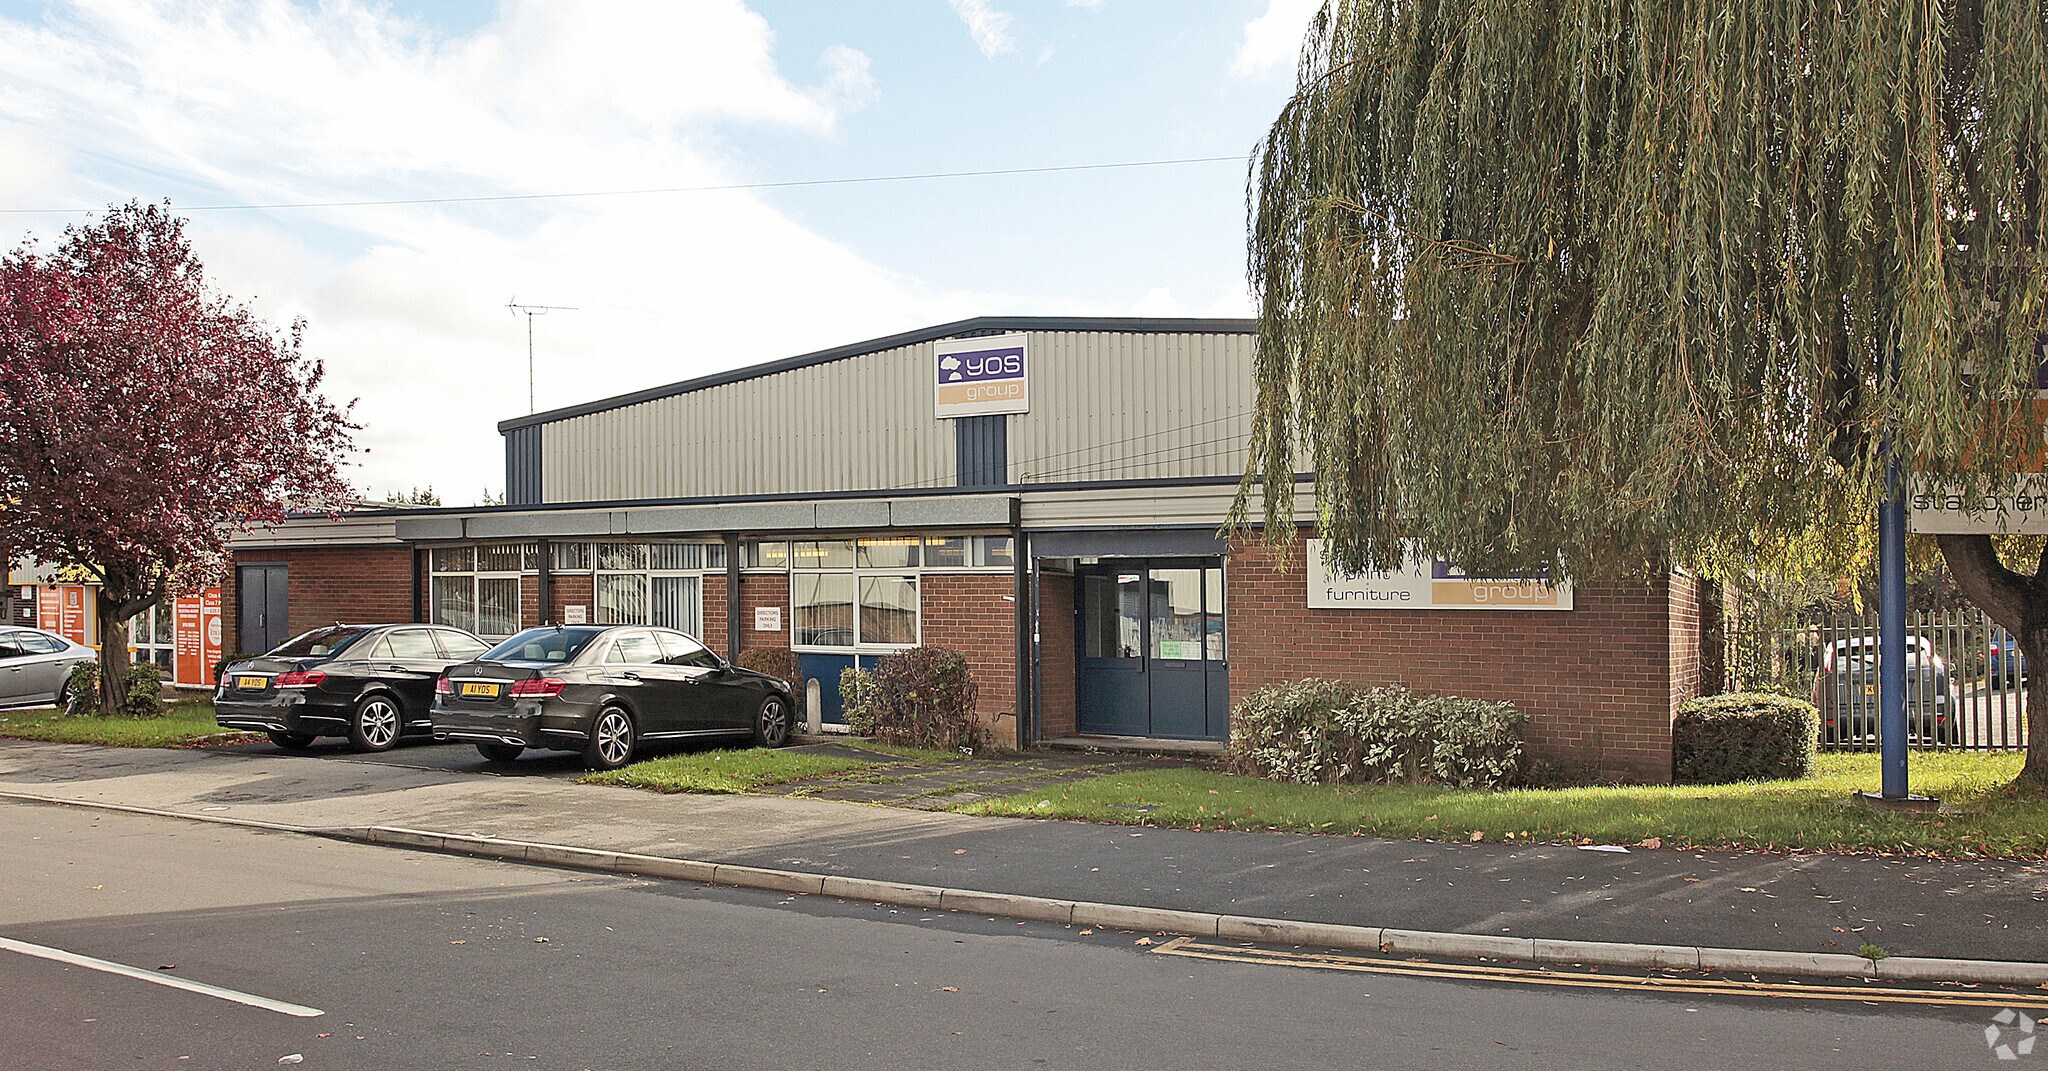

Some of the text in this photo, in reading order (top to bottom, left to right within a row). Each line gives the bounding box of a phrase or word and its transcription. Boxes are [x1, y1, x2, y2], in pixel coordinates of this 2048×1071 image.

[966, 384, 1019, 400] group
[1913, 492, 2046, 511] staoer
[1326, 587, 1411, 601] furniture
[1474, 586, 1549, 602] group
[477, 685, 491, 694] YOS
